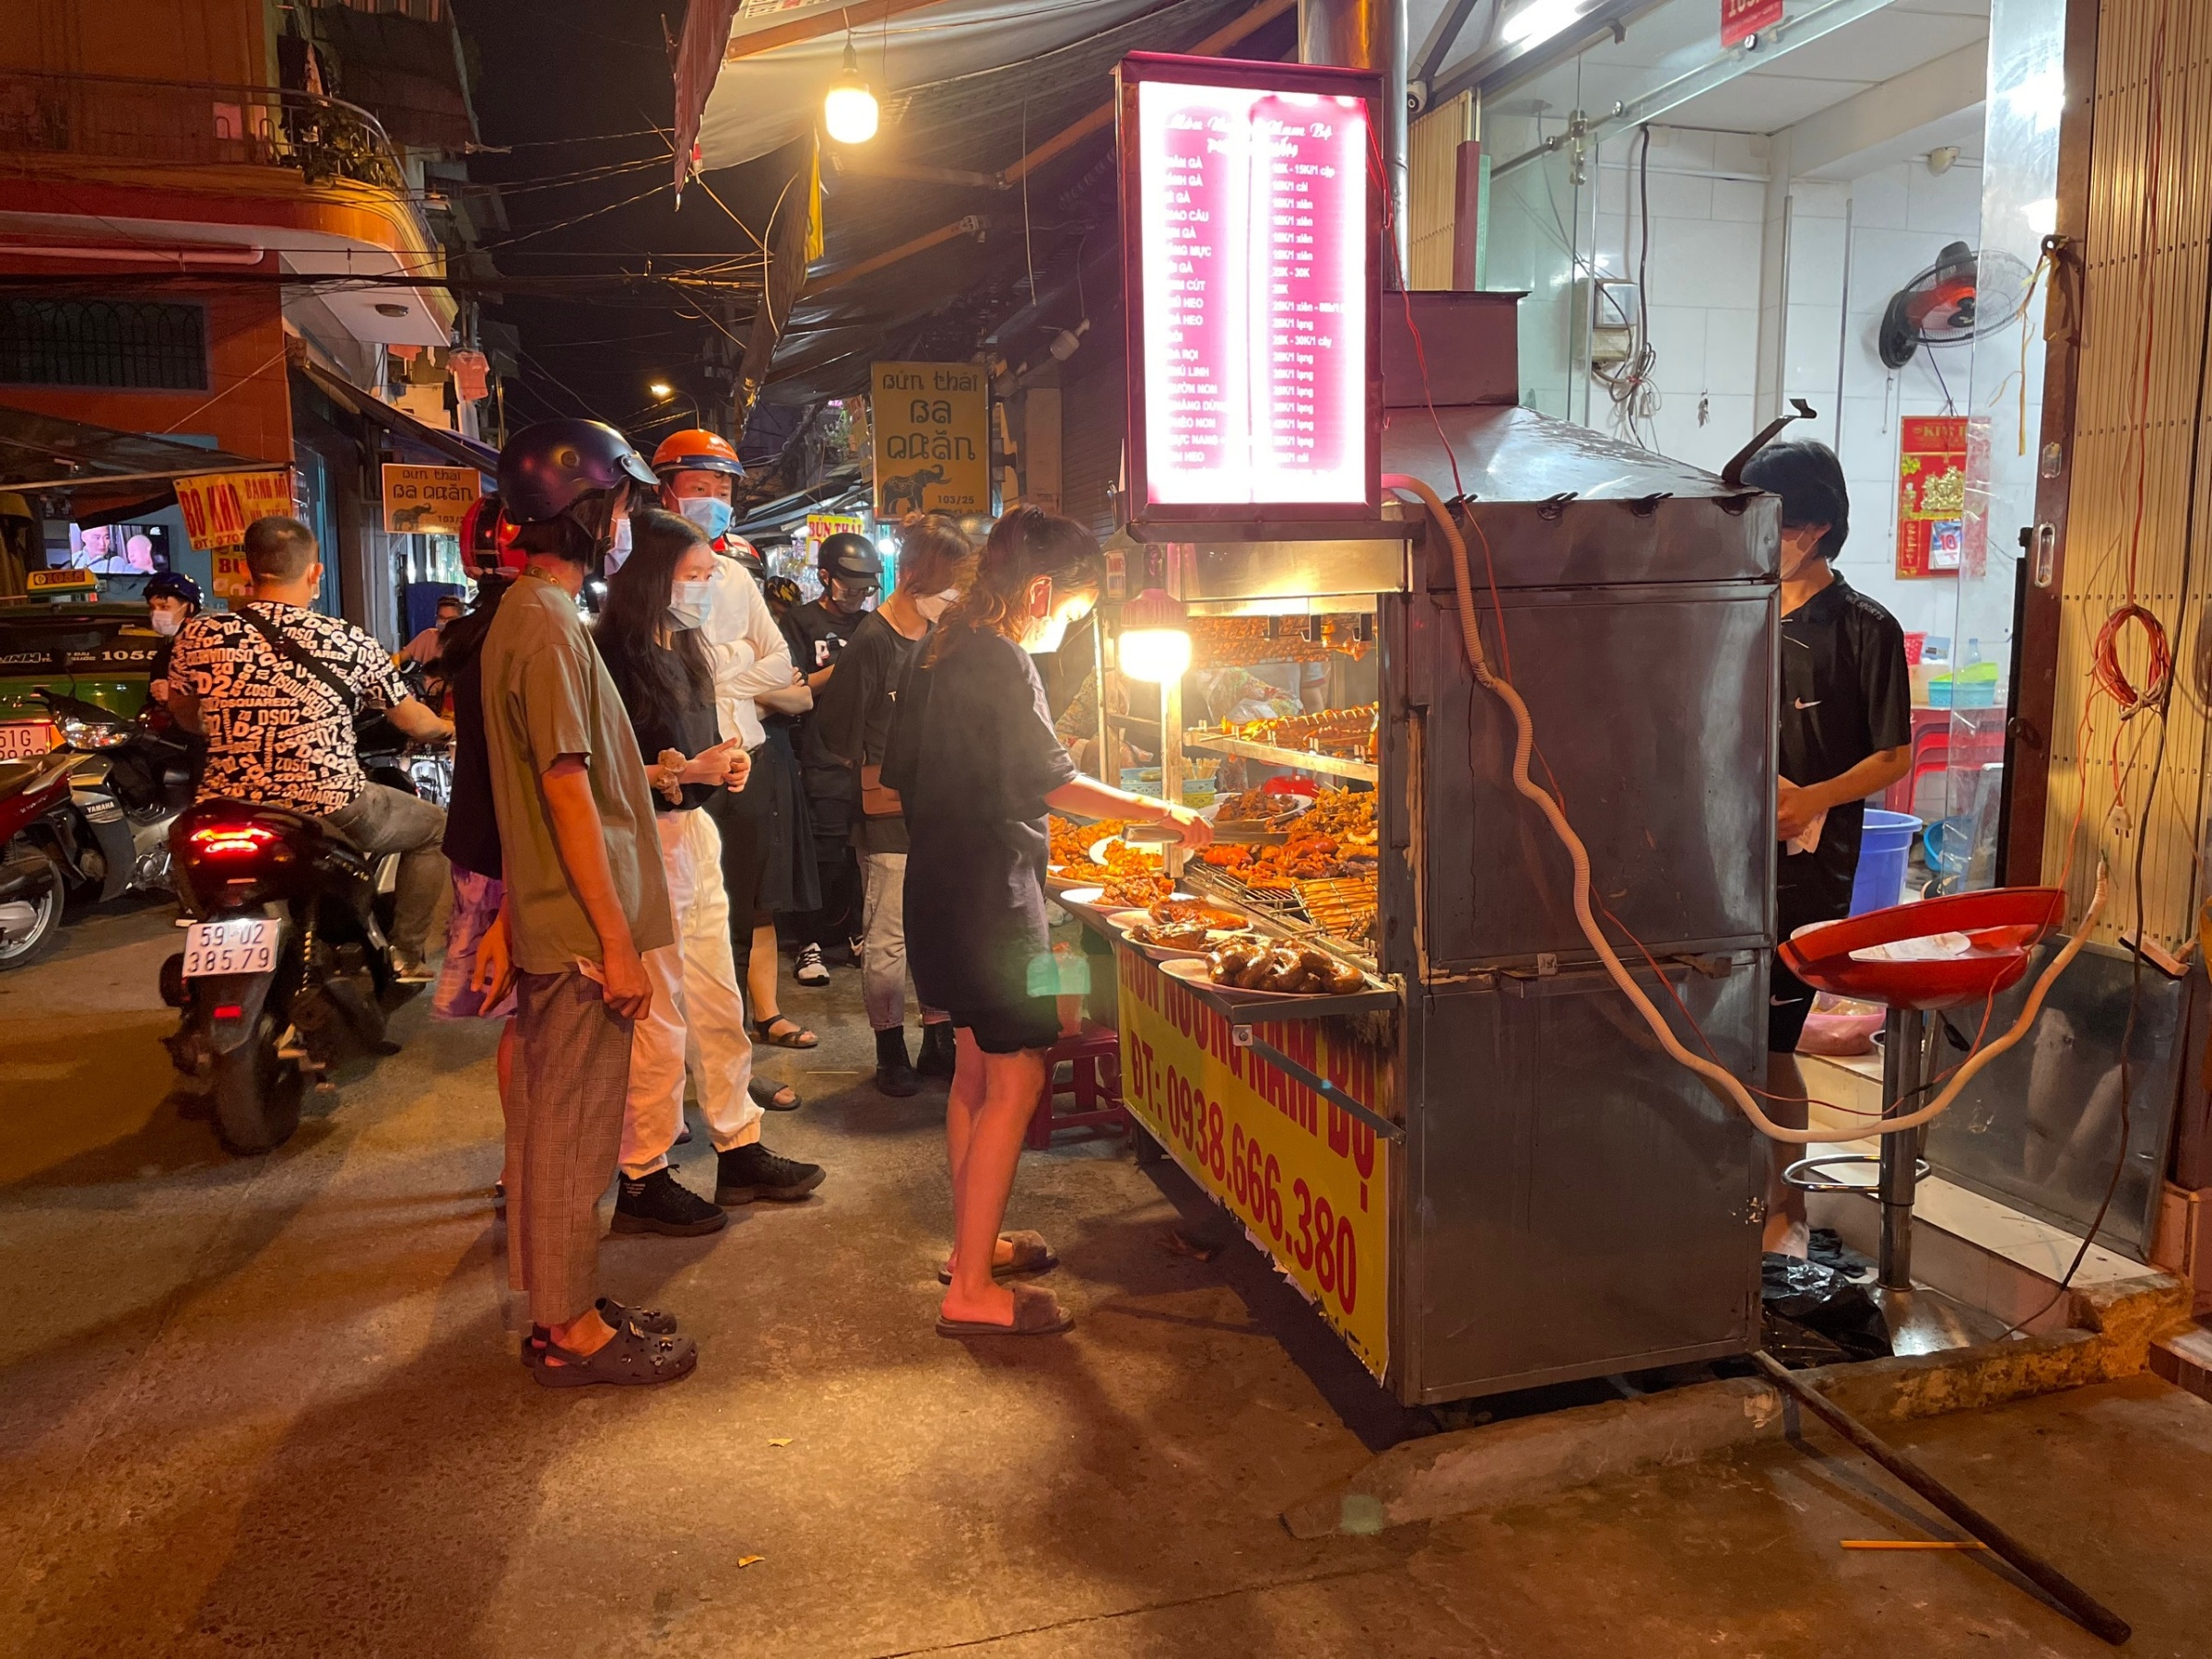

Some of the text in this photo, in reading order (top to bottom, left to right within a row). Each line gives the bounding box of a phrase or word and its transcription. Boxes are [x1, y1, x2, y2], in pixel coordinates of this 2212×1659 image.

[937, 495, 975, 505] 103/25
[215, 532, 245, 546] 070
[1938, 534, 1958, 551] 10
[47, 571, 86, 583] 1055
[220, 698, 300, 708] DSQUARED2
[257, 709, 300, 726] DSQ2
[87, 801, 115, 813] YAMAHA
[188, 947, 269, 972] 385.79
[1131, 1030, 1357, 1315] ĐT: 0938.666.380
